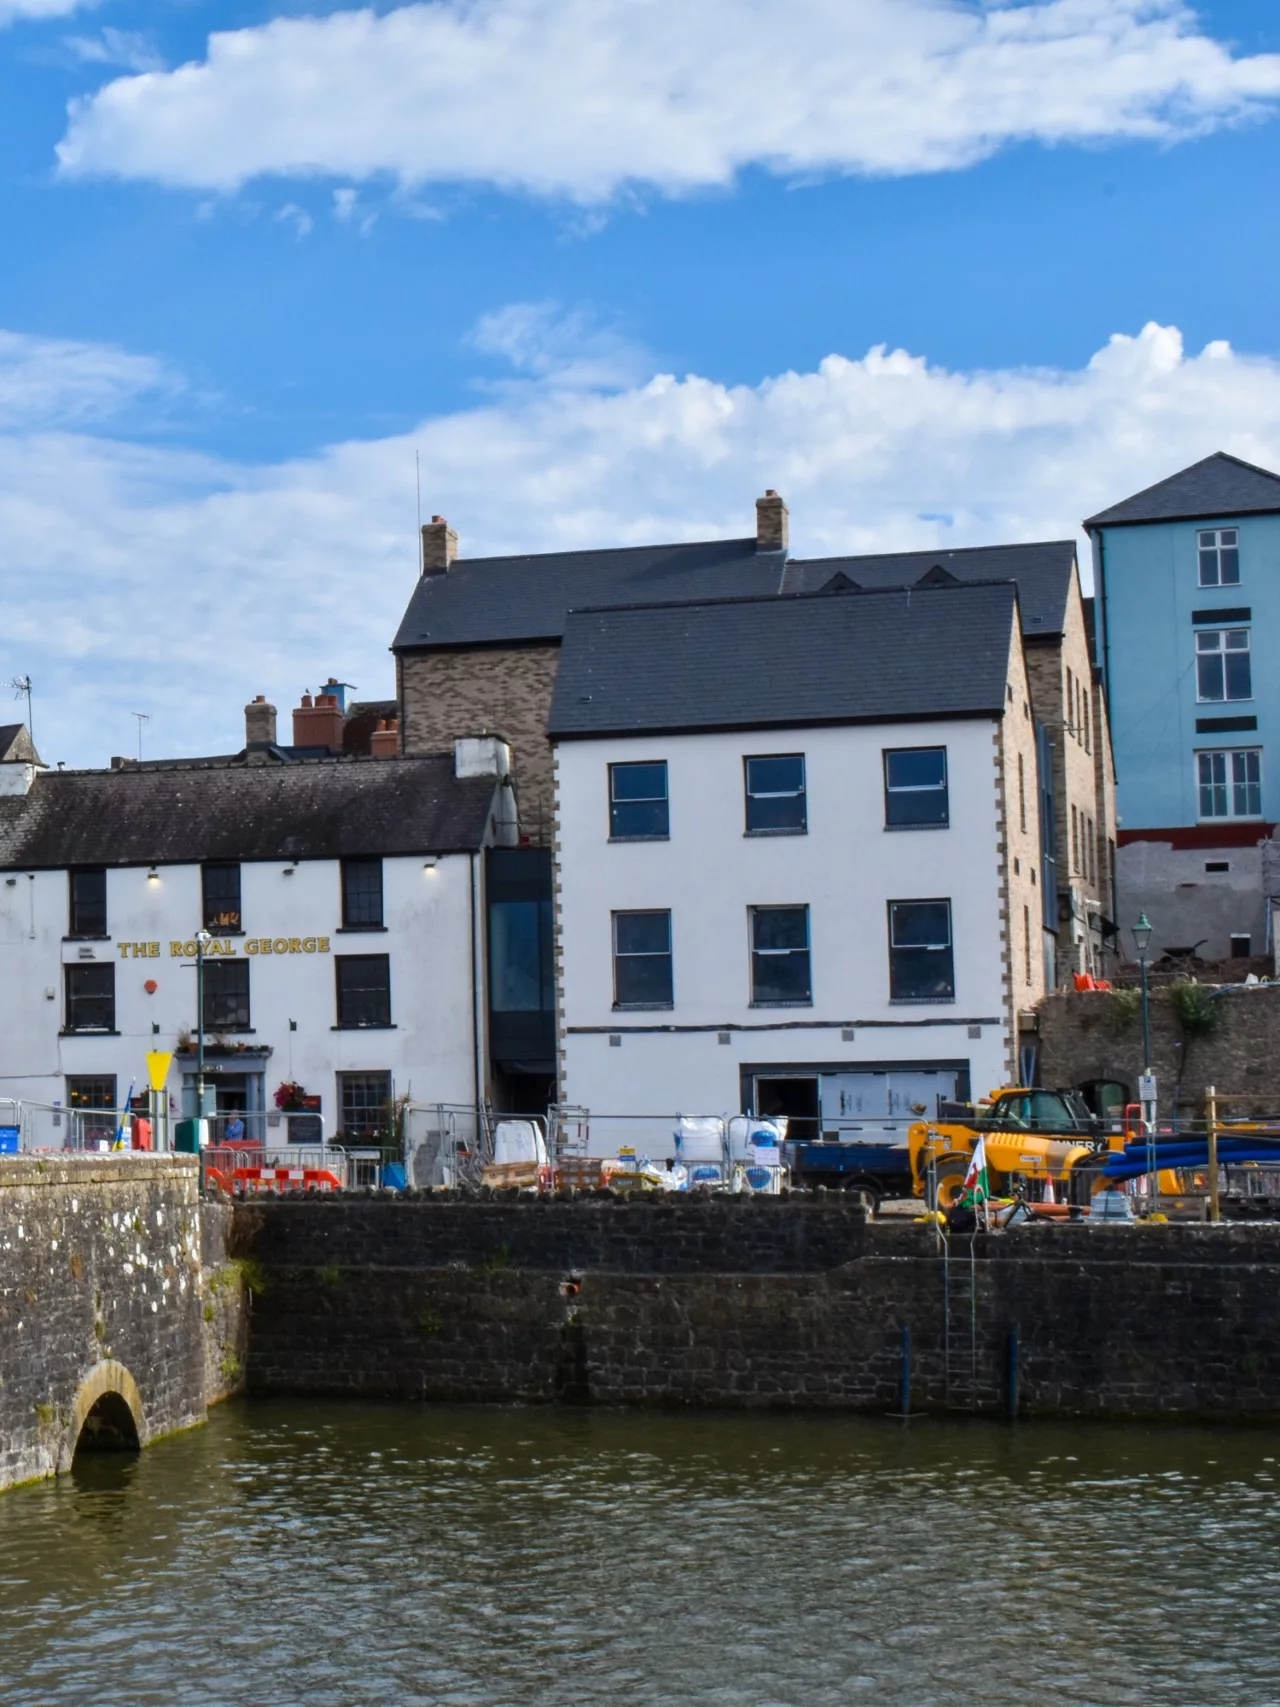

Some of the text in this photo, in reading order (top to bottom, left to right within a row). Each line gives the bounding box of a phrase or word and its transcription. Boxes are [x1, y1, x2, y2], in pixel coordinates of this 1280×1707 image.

[117, 937, 331, 958] THE ROYAL GEORGE
